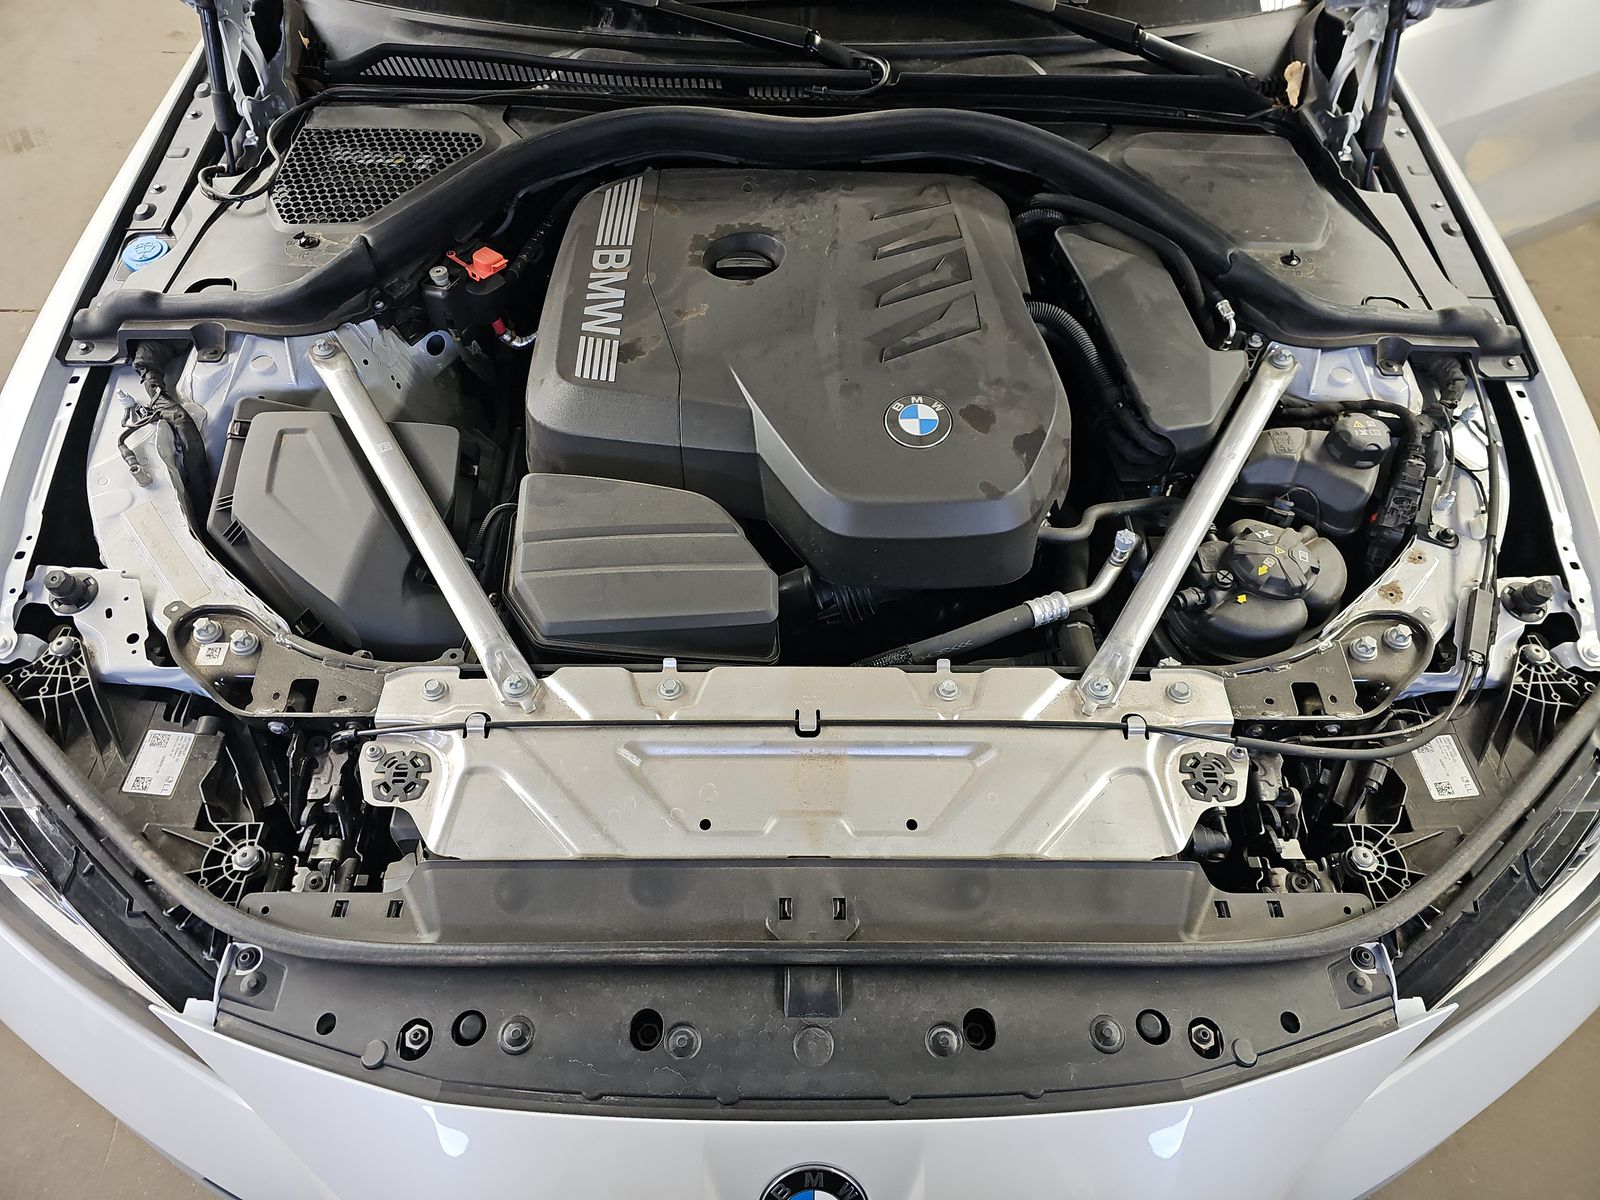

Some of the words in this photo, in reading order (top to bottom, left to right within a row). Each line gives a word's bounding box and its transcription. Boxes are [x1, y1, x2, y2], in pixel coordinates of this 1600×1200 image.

[581, 249, 632, 336] BMW
[891, 396, 945, 412] BMW
[770, 1172, 859, 1200] BMW
